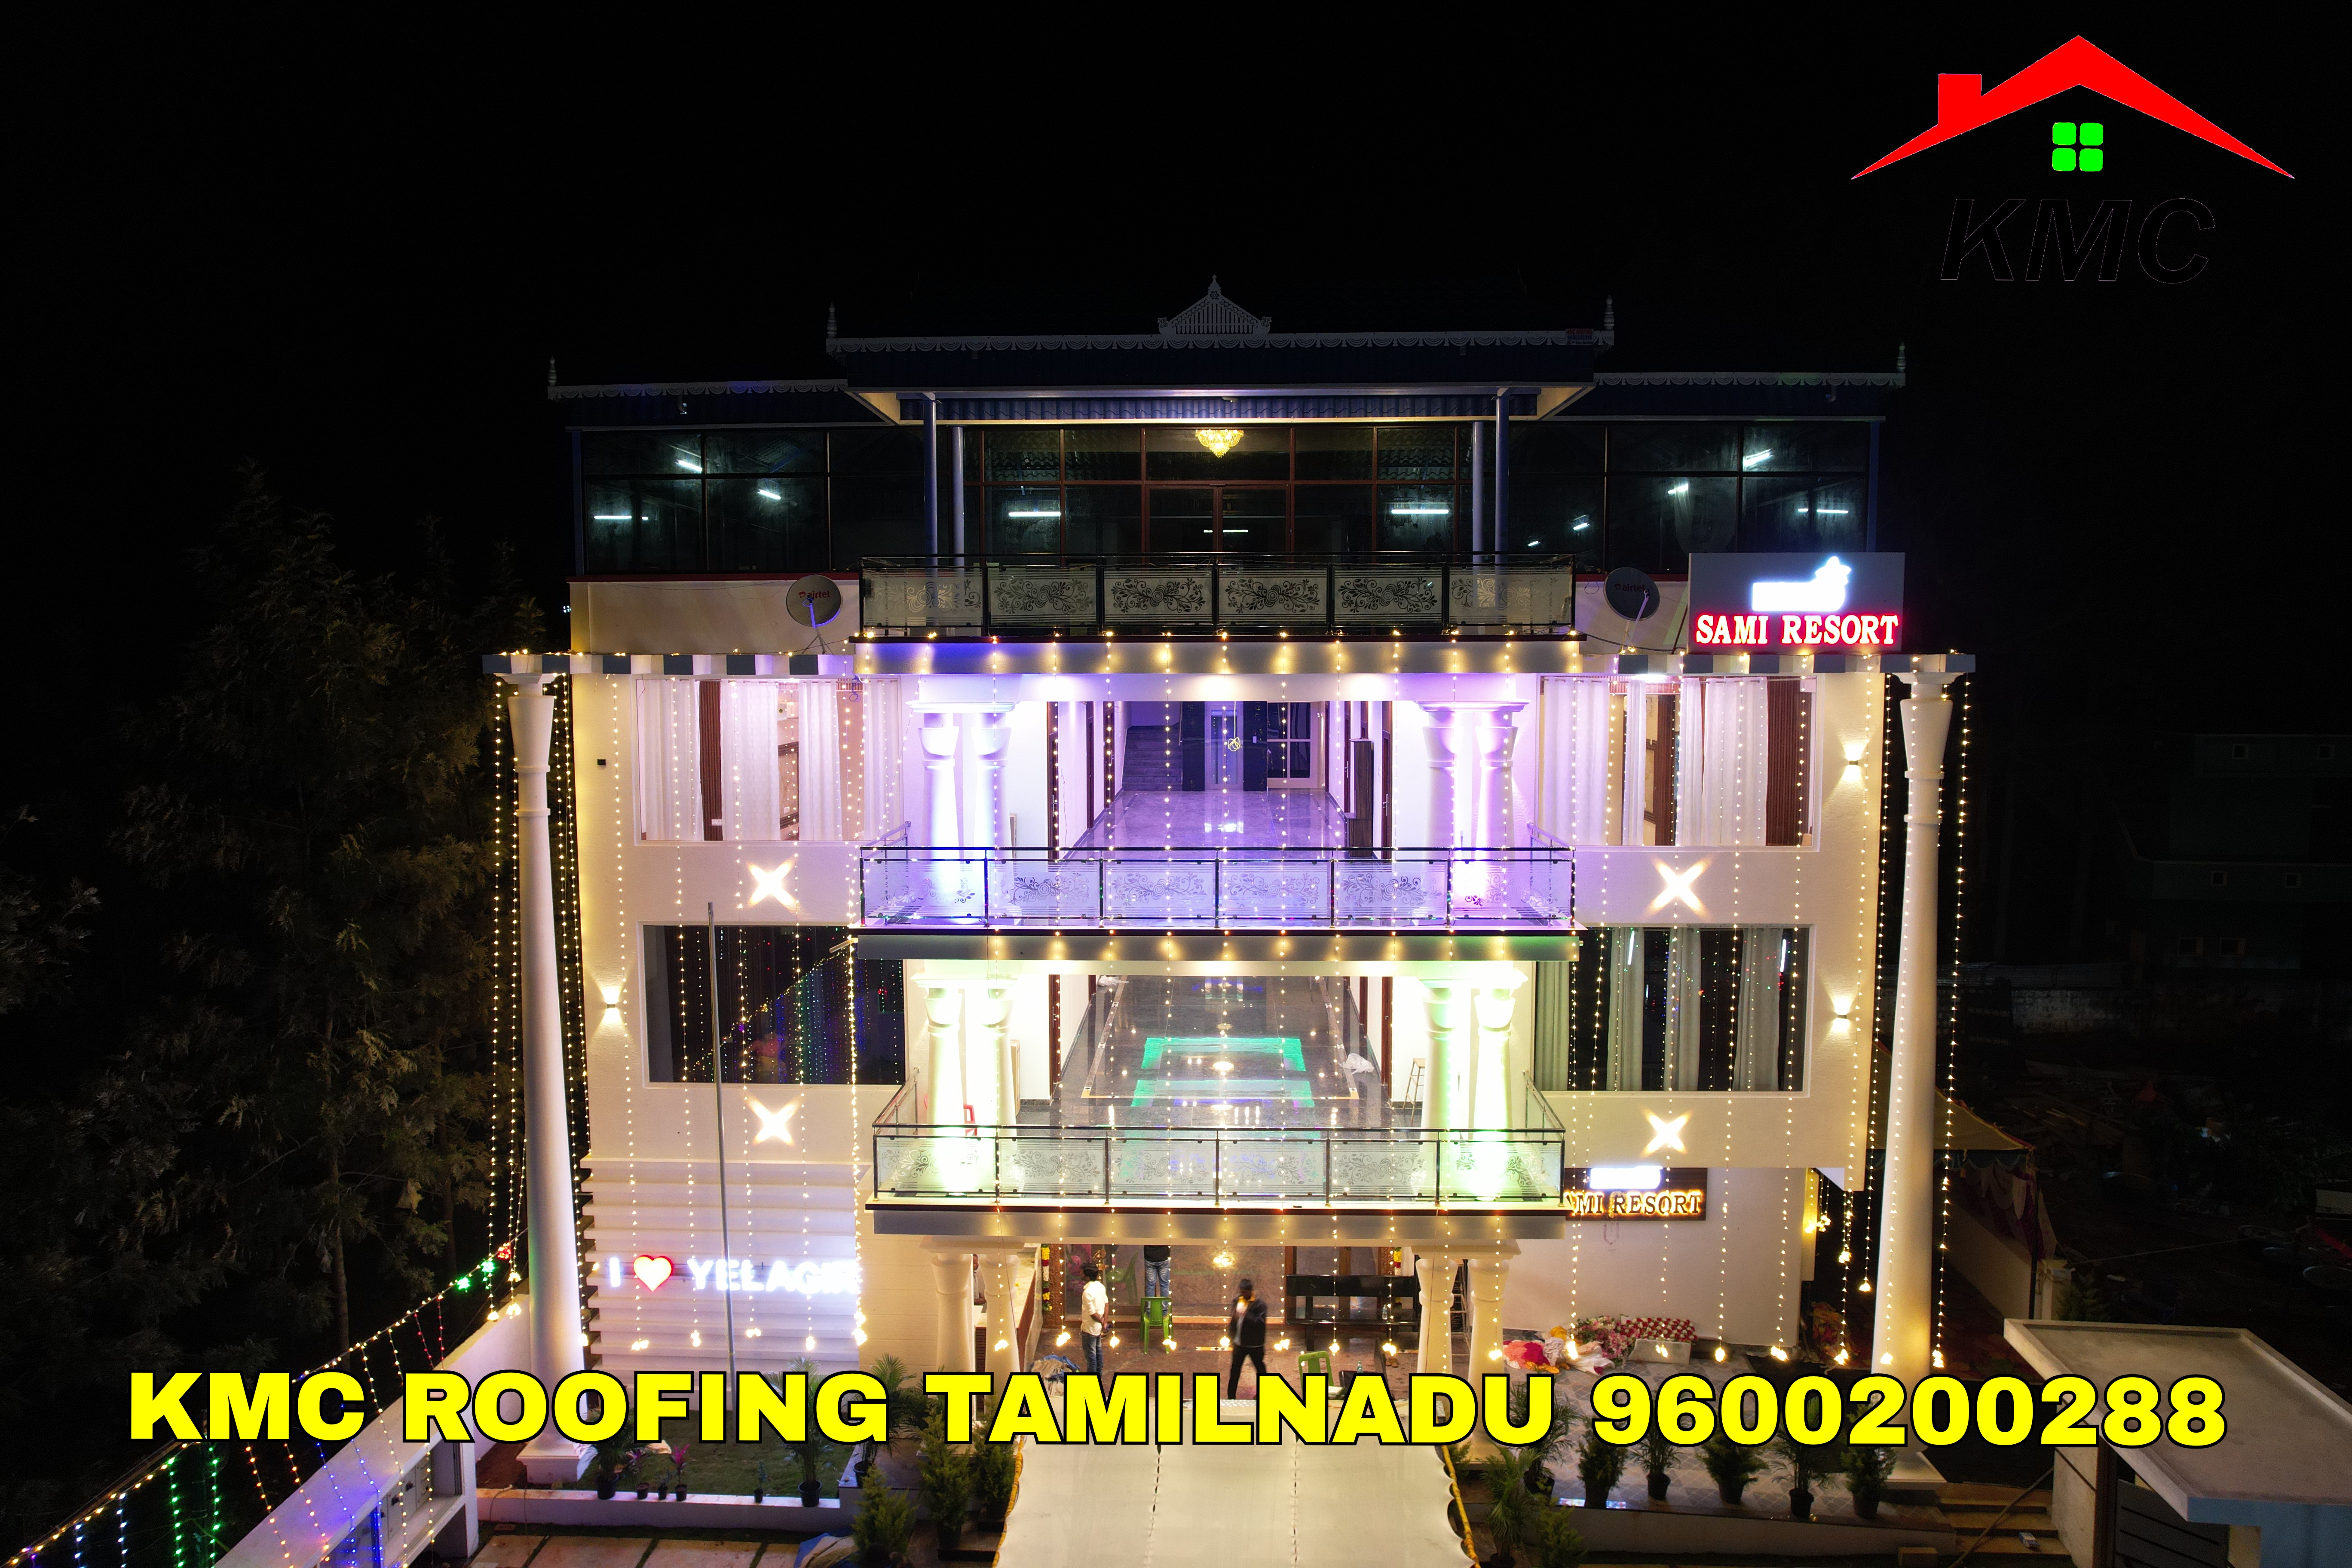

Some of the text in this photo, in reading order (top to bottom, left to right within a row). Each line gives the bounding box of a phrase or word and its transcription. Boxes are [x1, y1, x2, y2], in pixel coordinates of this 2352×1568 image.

[1622, 583, 1645, 592] airtel
[1696, 614, 1899, 644] SAMI RESORT
[1613, 1194, 1701, 1215] RESORT
[609, 1257, 621, 1287] I
